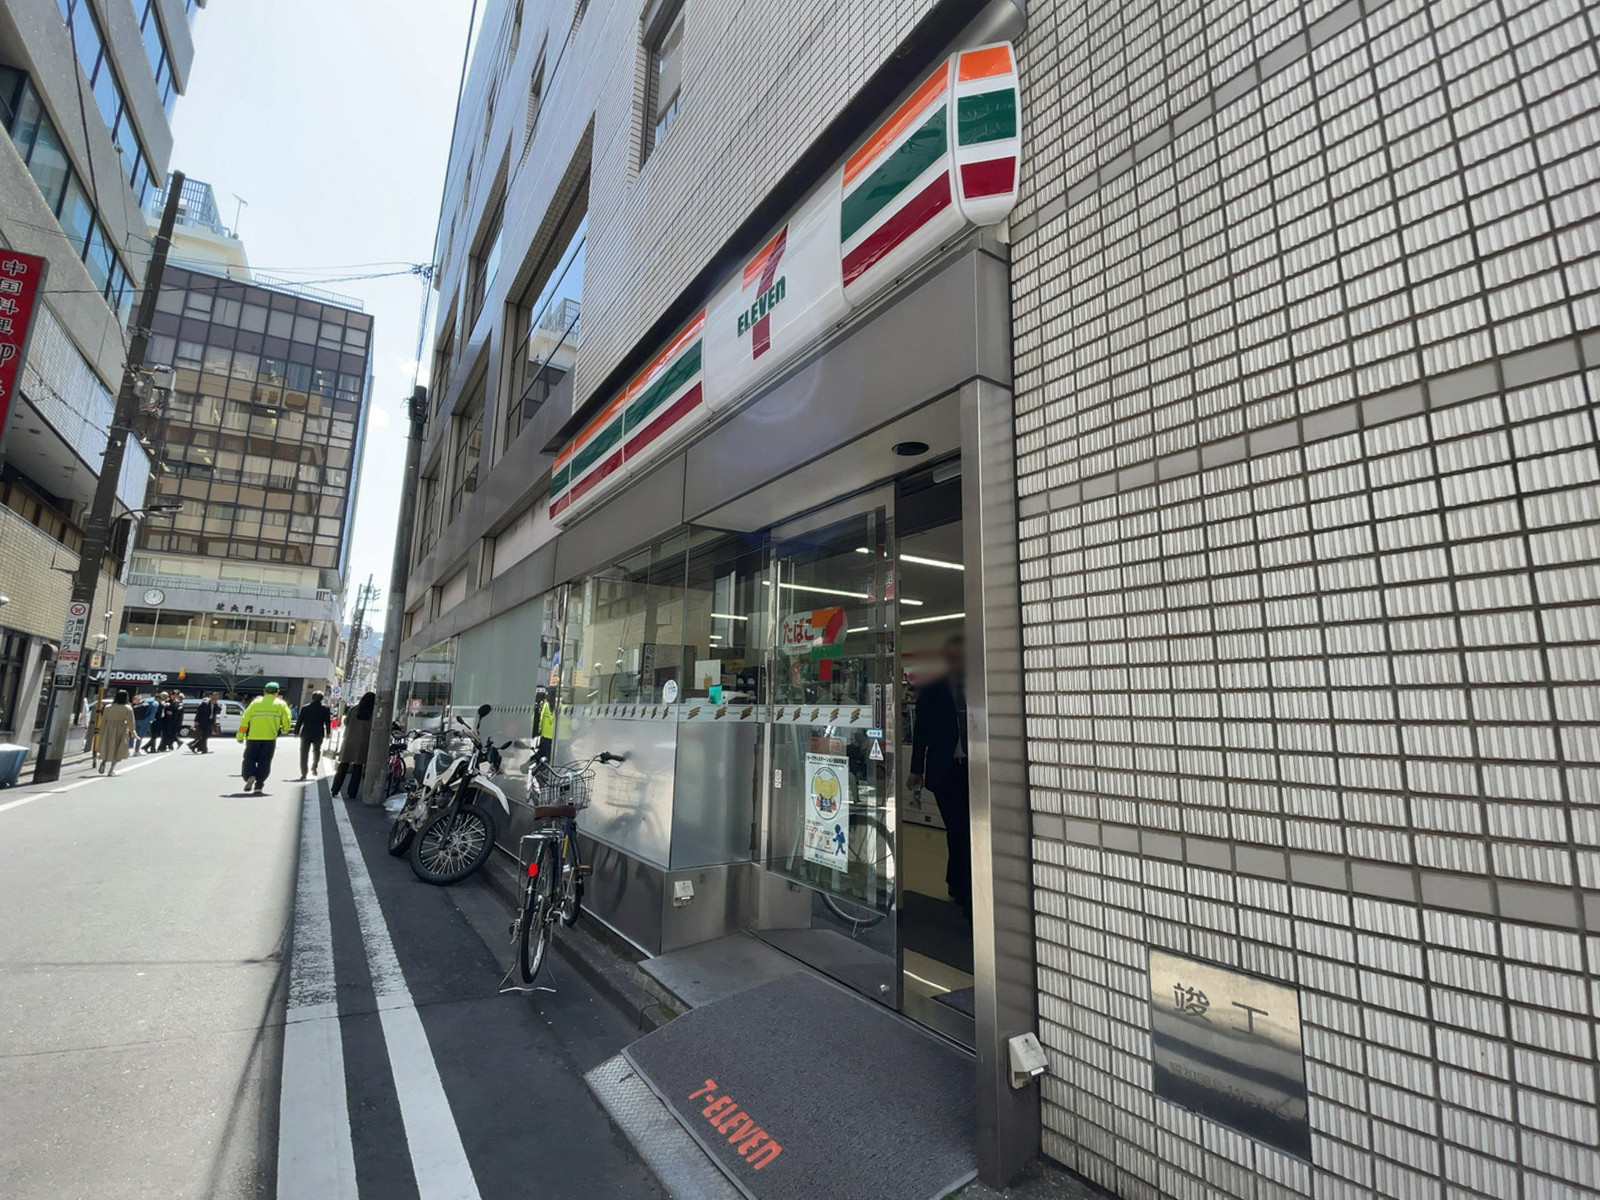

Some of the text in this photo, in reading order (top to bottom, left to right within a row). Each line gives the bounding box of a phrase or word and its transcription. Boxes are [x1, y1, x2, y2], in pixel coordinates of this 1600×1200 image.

[742, 222, 788, 360] 7
[96, 670, 168, 682] McDonald's
[1173, 982, 1269, 1034] 竣工
